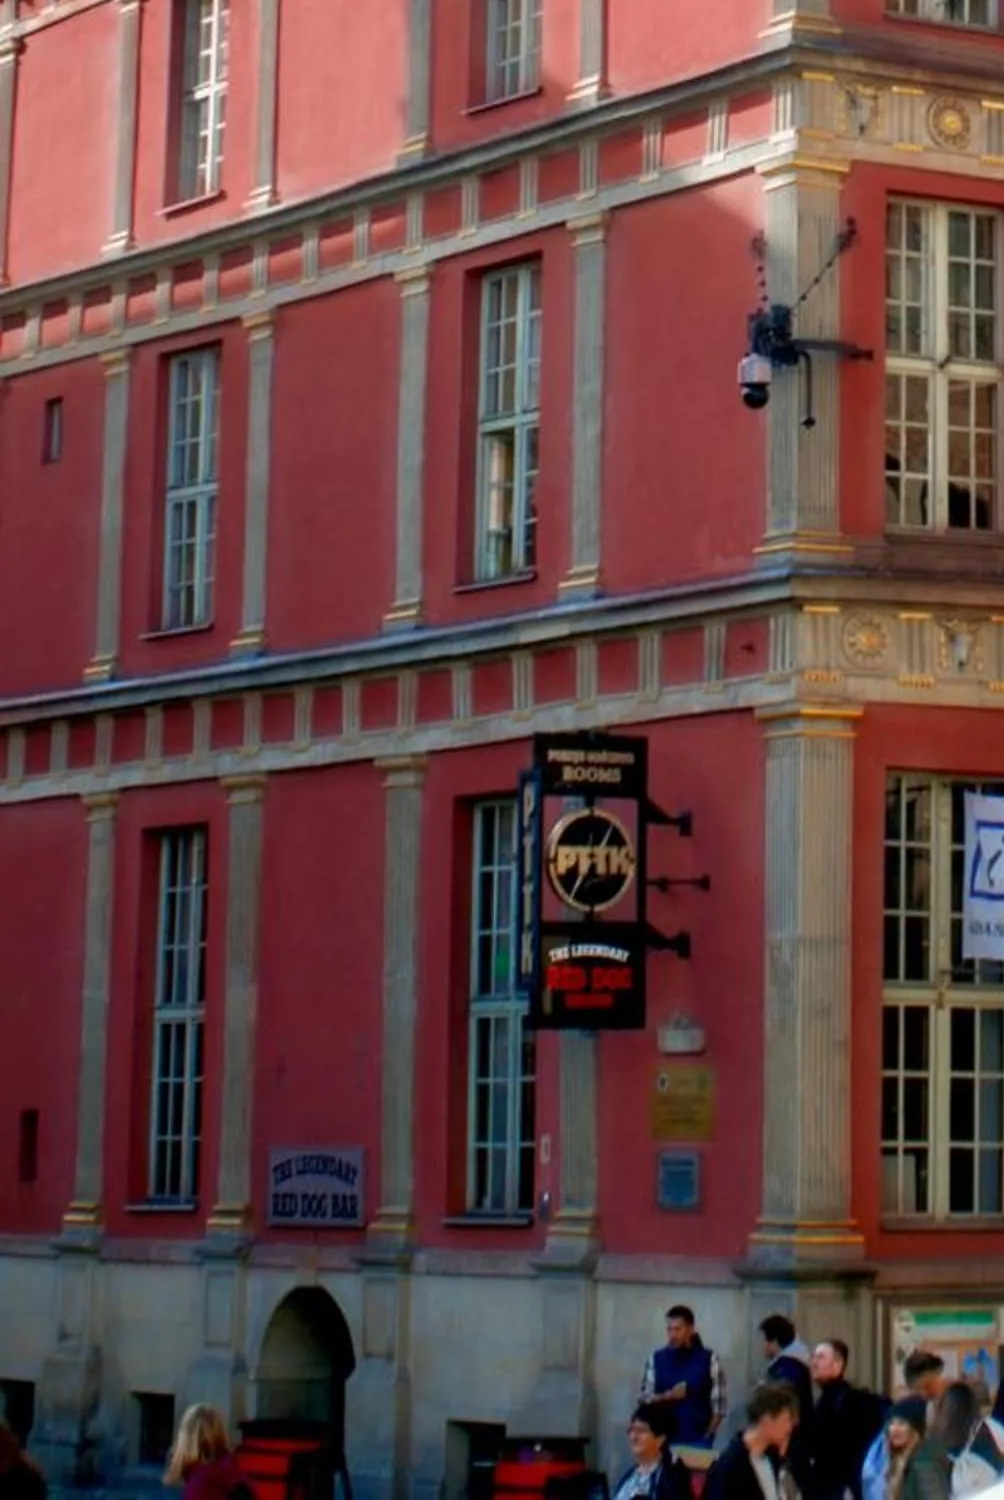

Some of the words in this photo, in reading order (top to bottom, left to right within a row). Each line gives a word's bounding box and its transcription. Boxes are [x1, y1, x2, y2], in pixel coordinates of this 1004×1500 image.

[563, 765, 621, 782] ROOMS
[556, 845, 632, 876] PTTK
[522, 783, 535, 974] PTTK
[548, 947, 570, 963] THE
[273, 1158, 292, 1187] THE
[296, 1154, 358, 1186] LEGENDARY
[272, 1192, 298, 1217] RED
[301, 1192, 328, 1219] DOG
[331, 1192, 358, 1219] BAR
